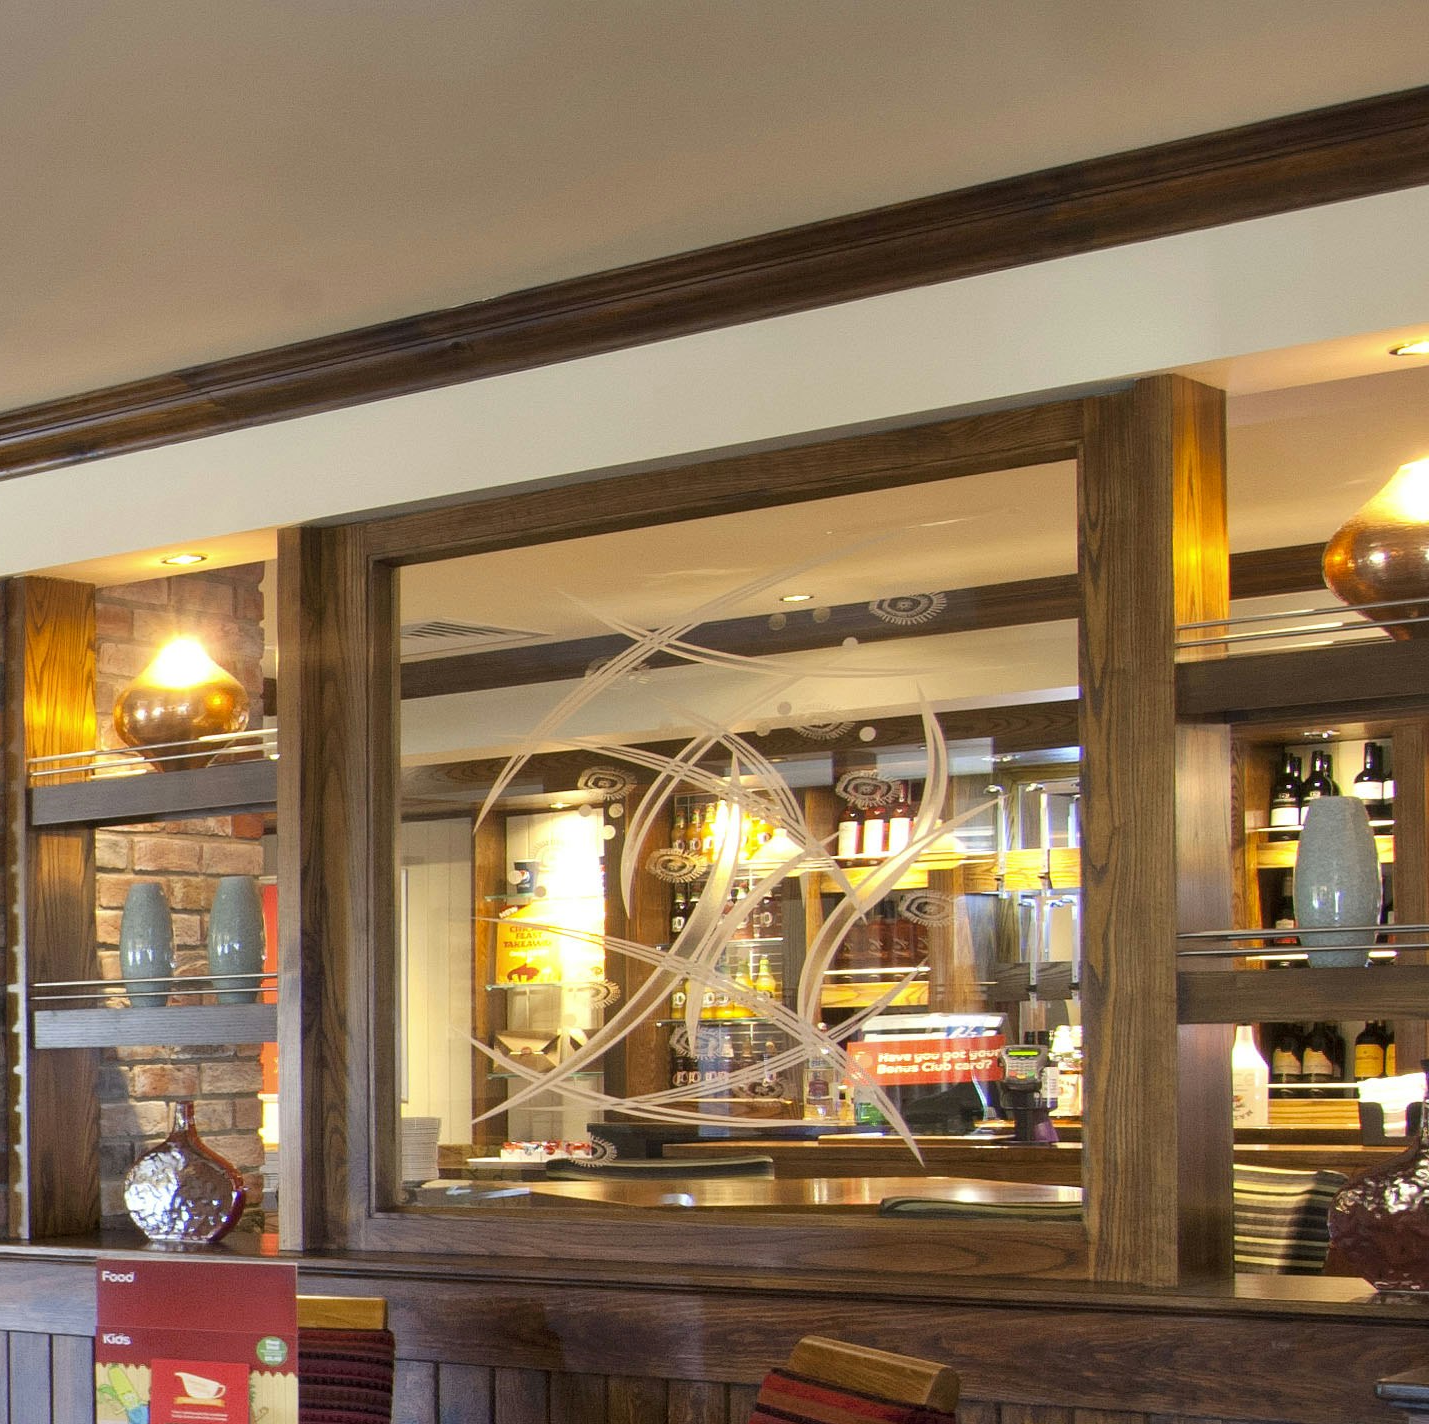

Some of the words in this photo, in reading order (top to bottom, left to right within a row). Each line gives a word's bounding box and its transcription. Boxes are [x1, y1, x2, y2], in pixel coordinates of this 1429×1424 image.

[878, 1051, 913, 1063] Have
[913, 1052, 940, 1063] you
[942, 1050, 967, 1061] got
[969, 1049, 1002, 1061] your
[877, 1063, 919, 1075] Bonus
[921, 1061, 952, 1073] Club
[954, 1059, 993, 1071] card?
[102, 1270, 135, 1283] Food
[103, 1333, 132, 1345] Kids
